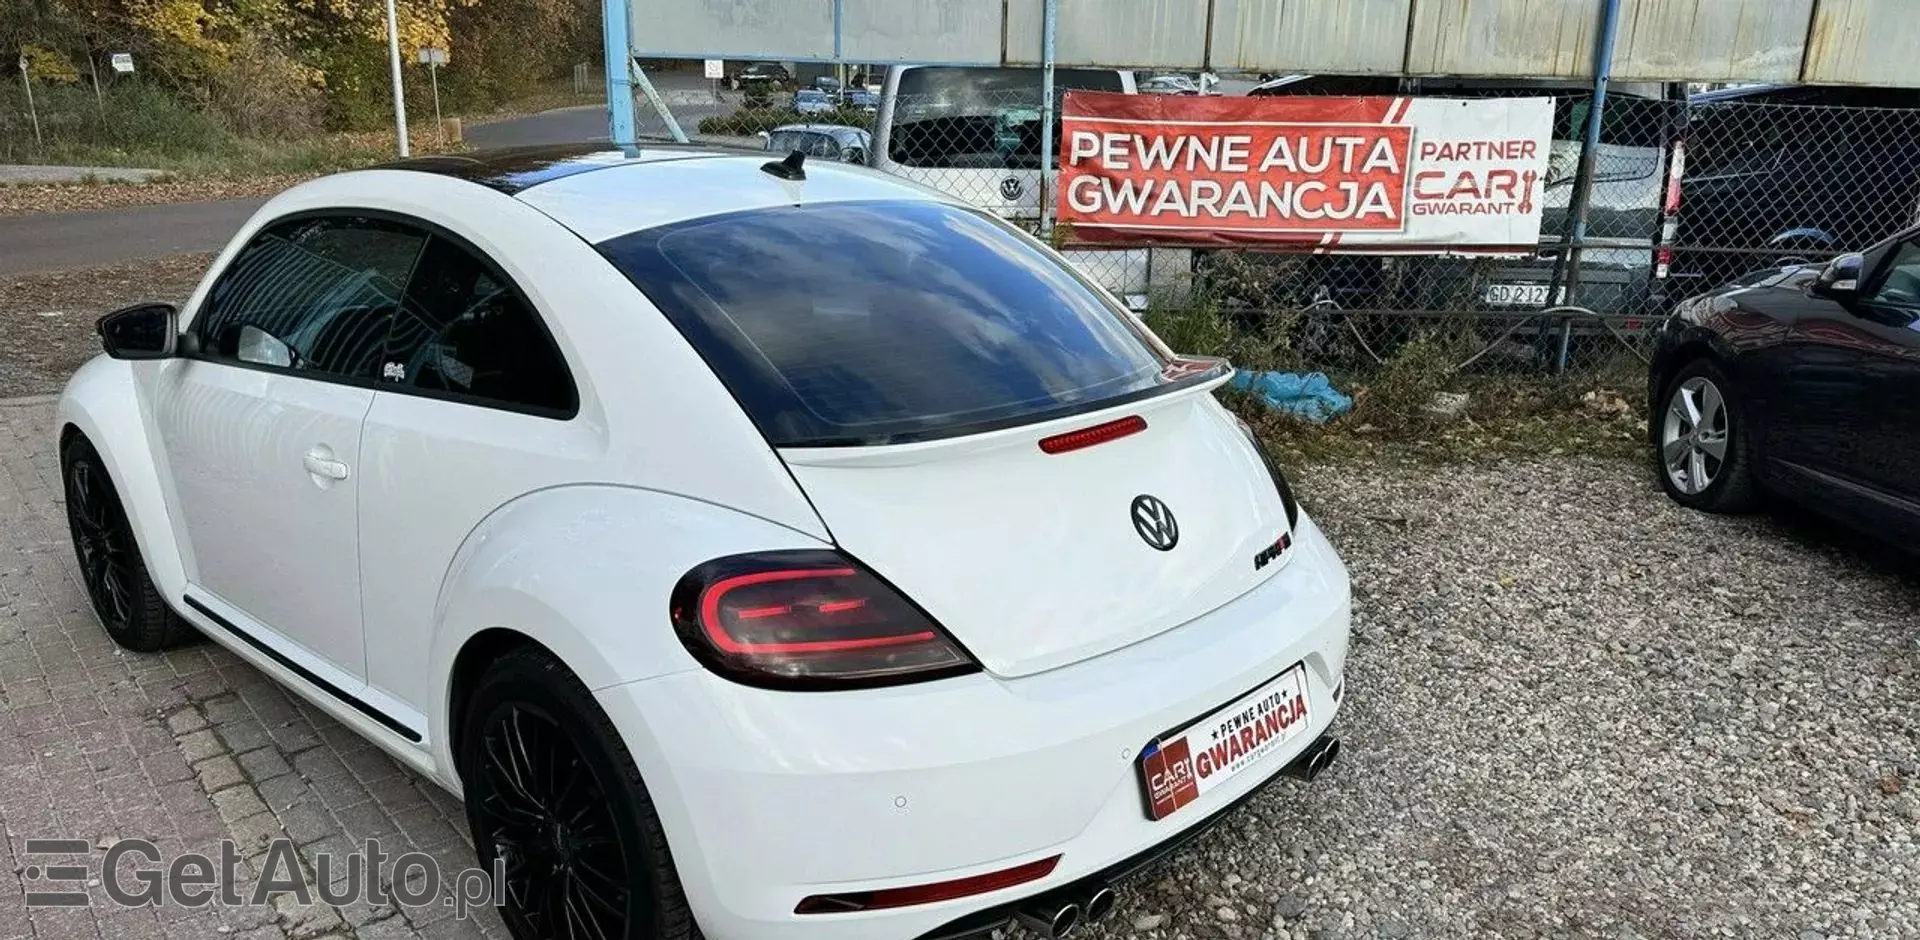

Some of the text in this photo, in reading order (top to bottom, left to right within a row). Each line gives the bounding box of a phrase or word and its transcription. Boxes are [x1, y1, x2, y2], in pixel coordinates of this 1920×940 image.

[1069, 131, 1400, 174] PEWNE AUTA
[1420, 141, 1537, 161] PARTNER
[1067, 174, 1396, 219] GWARANCJA
[1413, 169, 1518, 200] CAR
[1412, 202, 1516, 215] GWARANT
[1489, 286, 1509, 301] GD
[1220, 691, 1281, 739] PEWNE AUTO
[1195, 694, 1308, 779] GWARANCJA
